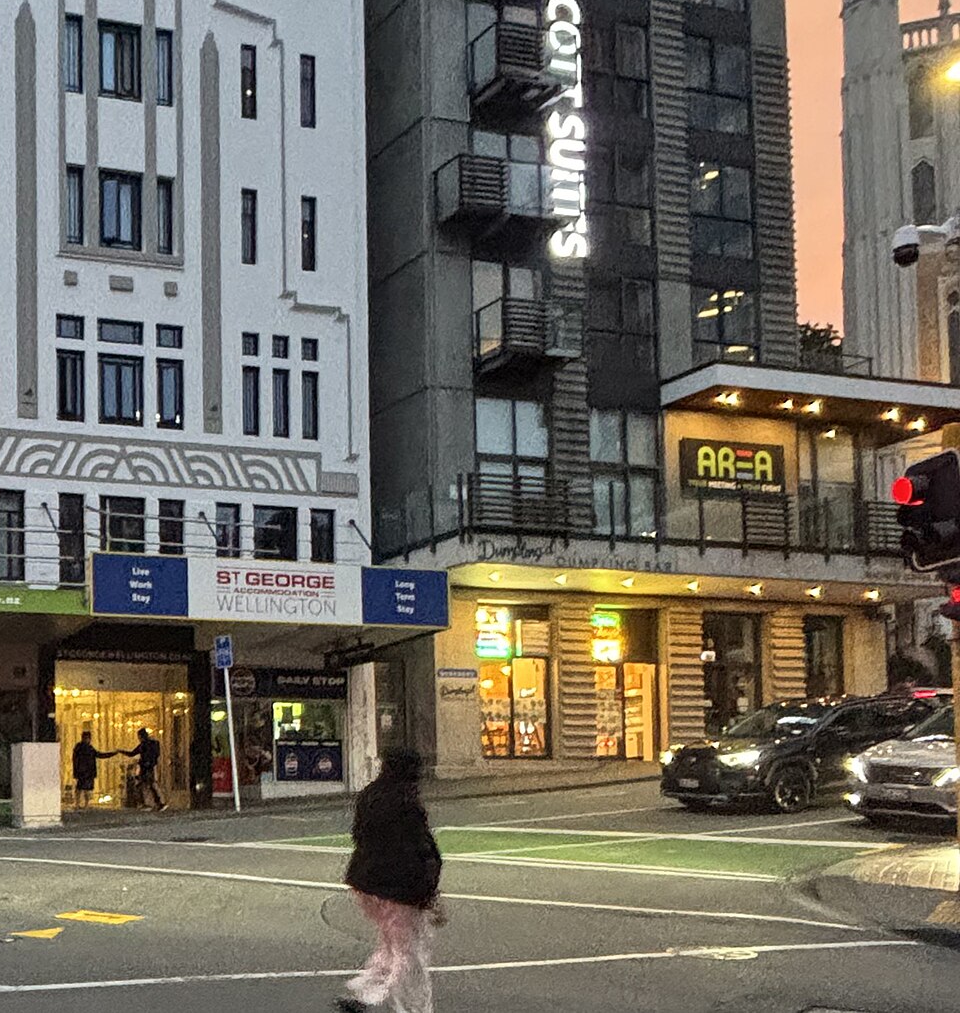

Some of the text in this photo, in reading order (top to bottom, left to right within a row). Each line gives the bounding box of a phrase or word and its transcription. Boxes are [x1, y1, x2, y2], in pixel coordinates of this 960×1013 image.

[697, 446, 772, 481] AREA
[132, 567, 150, 576] Live
[129, 580, 152, 589] Work
[216, 571, 335, 589] ST GEORGE
[394, 580, 415, 590] Long
[233, 588, 320, 598] ACCOMMODATION
[394, 592, 416, 601] Term
[132, 593, 151, 604] Stay
[216, 595, 337, 616] WELLINGTON
[396, 604, 415, 615] Stay
[312, 676, 345, 686] STOP
